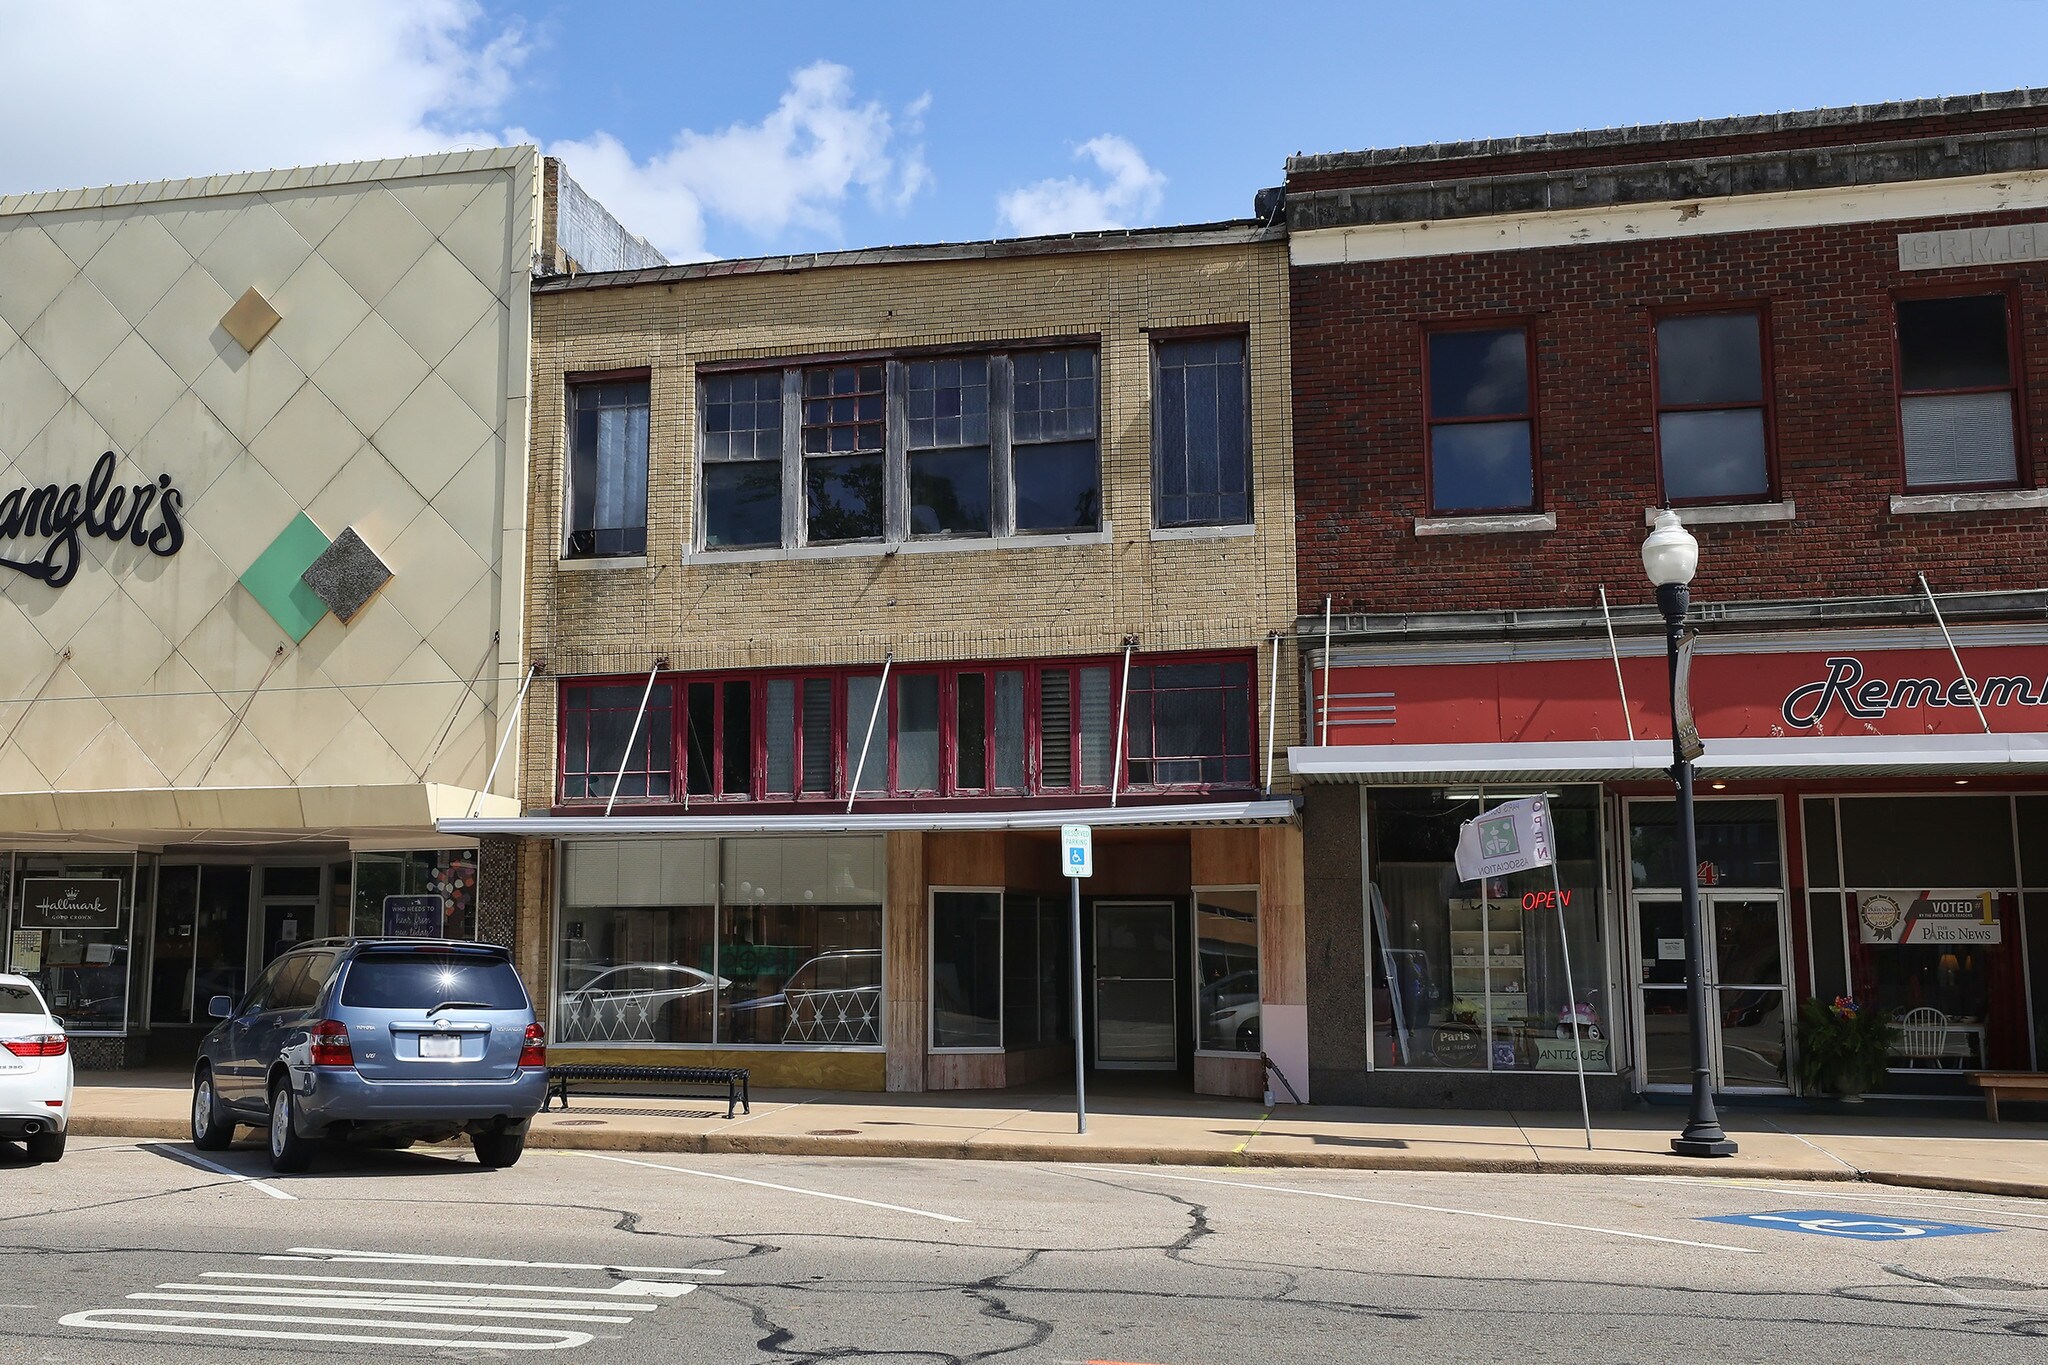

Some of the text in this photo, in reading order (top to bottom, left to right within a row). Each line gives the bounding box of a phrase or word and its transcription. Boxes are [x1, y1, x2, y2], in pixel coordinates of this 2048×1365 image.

[35, 896, 108, 917] Hallmark
[1521, 888, 1572, 911] OPEN
[1932, 901, 1973, 914] VOTED
[1976, 891, 2000, 926] 1
[1958, 927, 1992, 941] NEWS
[1439, 1031, 1471, 1042] Paris
